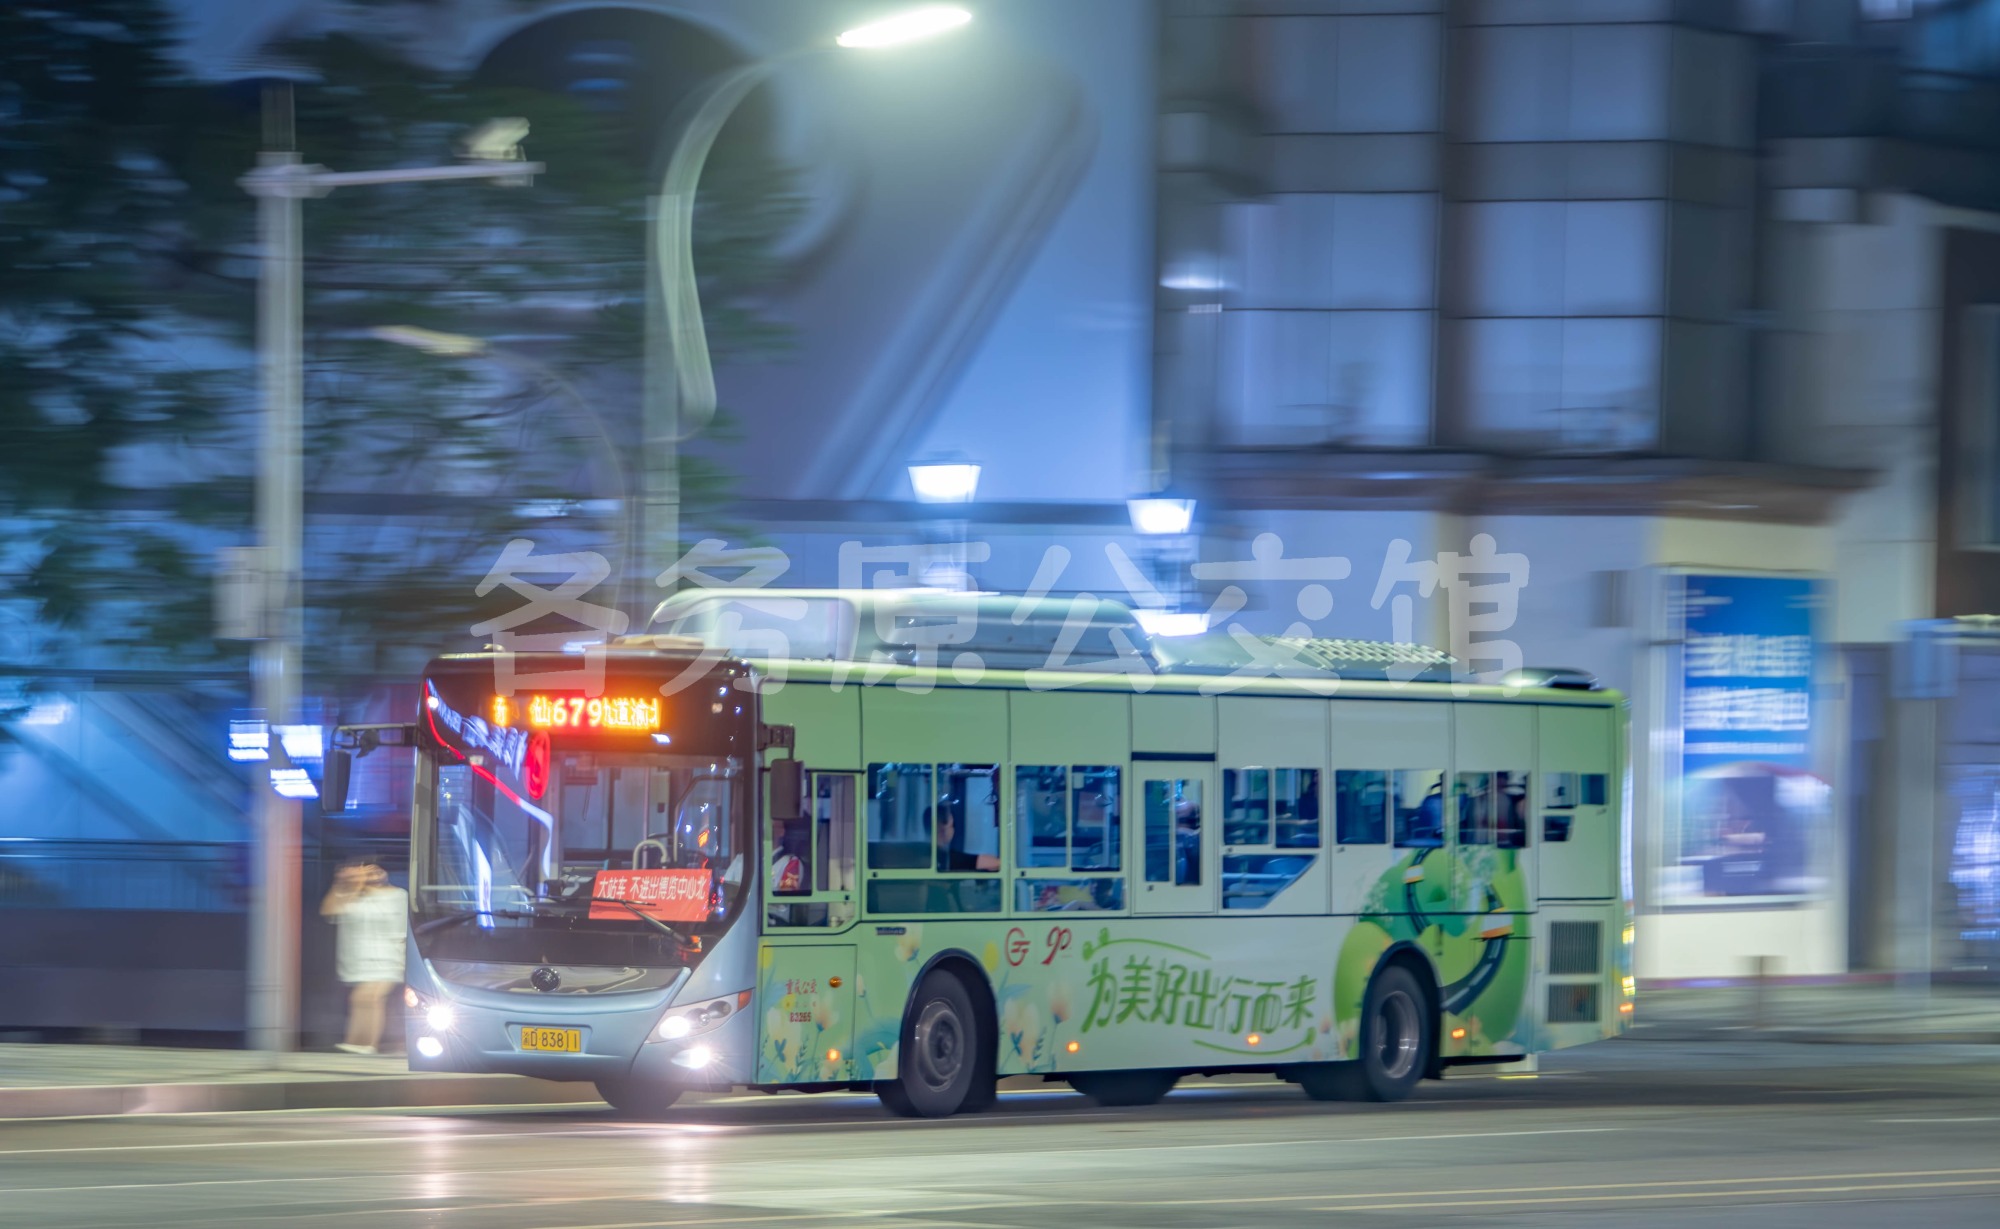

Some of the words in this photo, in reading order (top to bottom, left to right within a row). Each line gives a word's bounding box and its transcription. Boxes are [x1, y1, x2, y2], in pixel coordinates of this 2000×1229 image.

[553, 698, 601, 727] 679
[597, 877, 627, 899] 大站车
[630, 876, 706, 900] 不进出博览中心北
[1080, 955, 1317, 1035] 为美好出行而来
